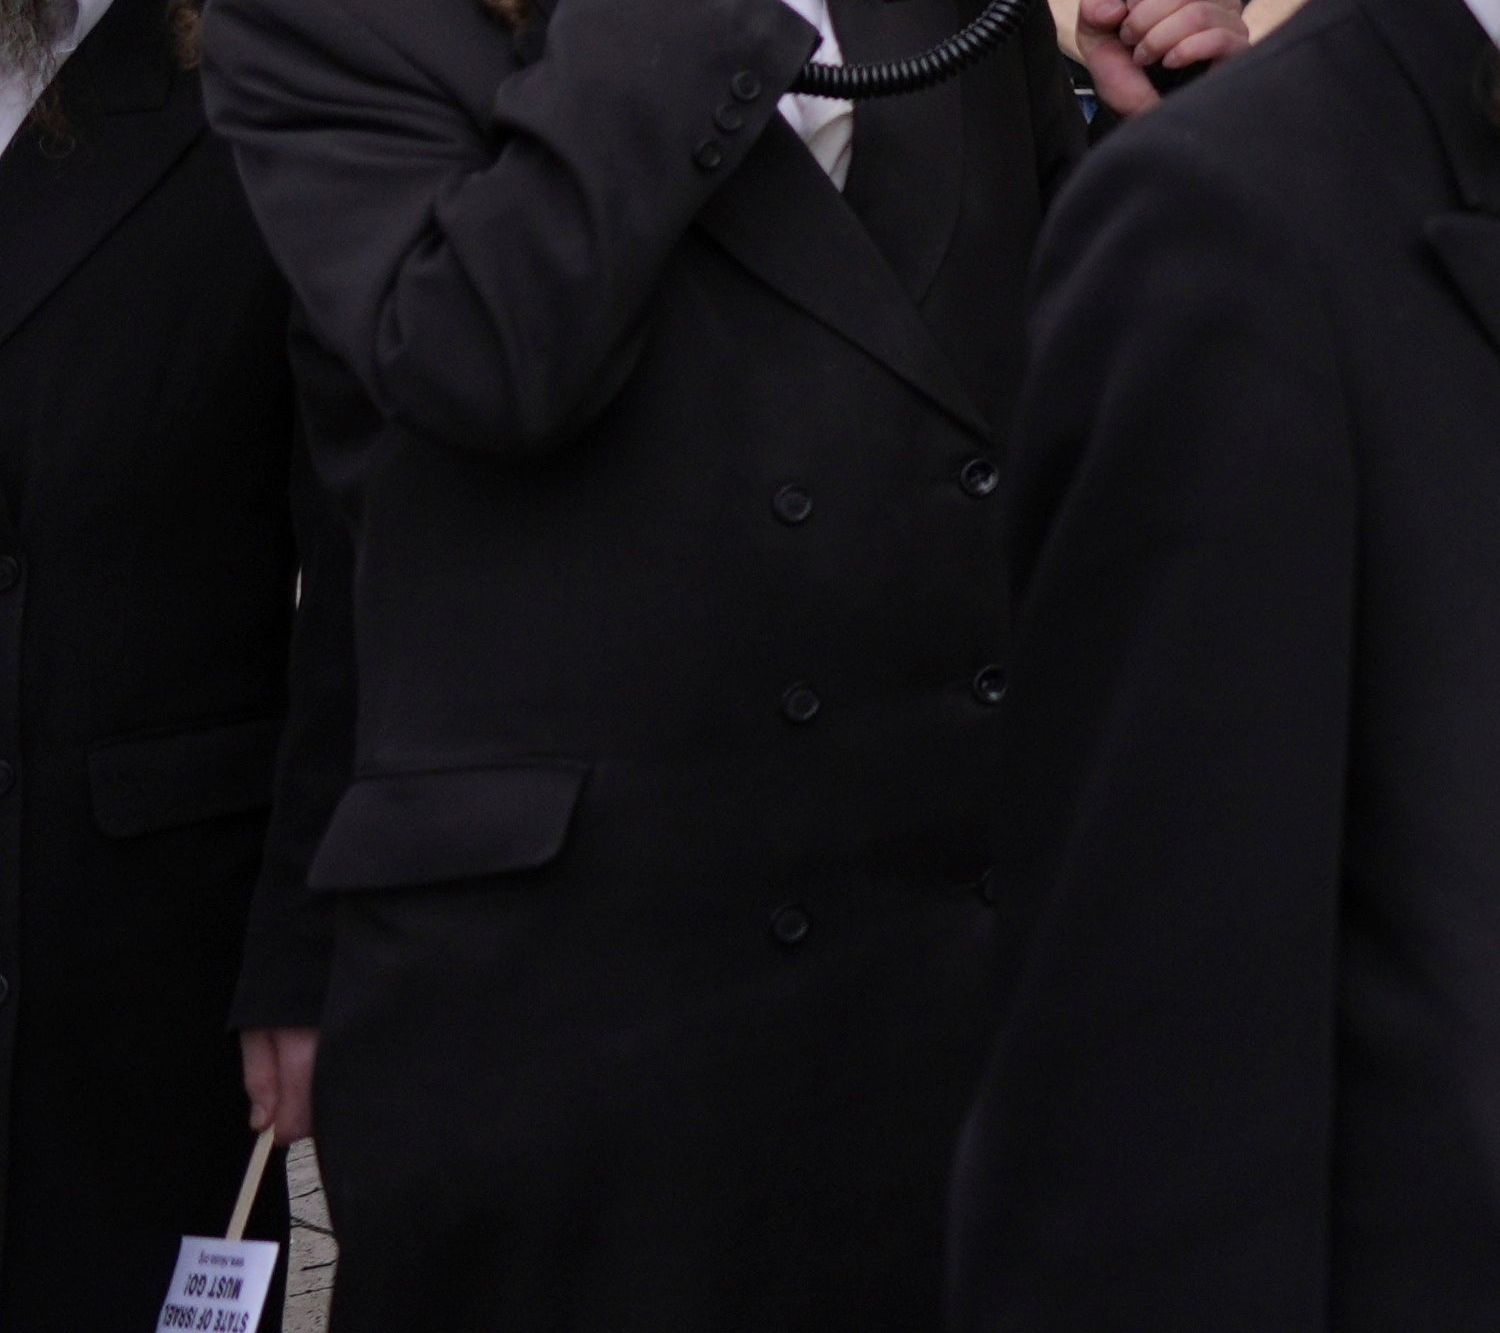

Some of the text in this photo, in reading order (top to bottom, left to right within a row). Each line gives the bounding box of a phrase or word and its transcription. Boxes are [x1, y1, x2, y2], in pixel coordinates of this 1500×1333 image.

[184, 1273, 243, 1300] MUST GO!
[164, 1303, 250, 1333] STATE OF ISRAEL
